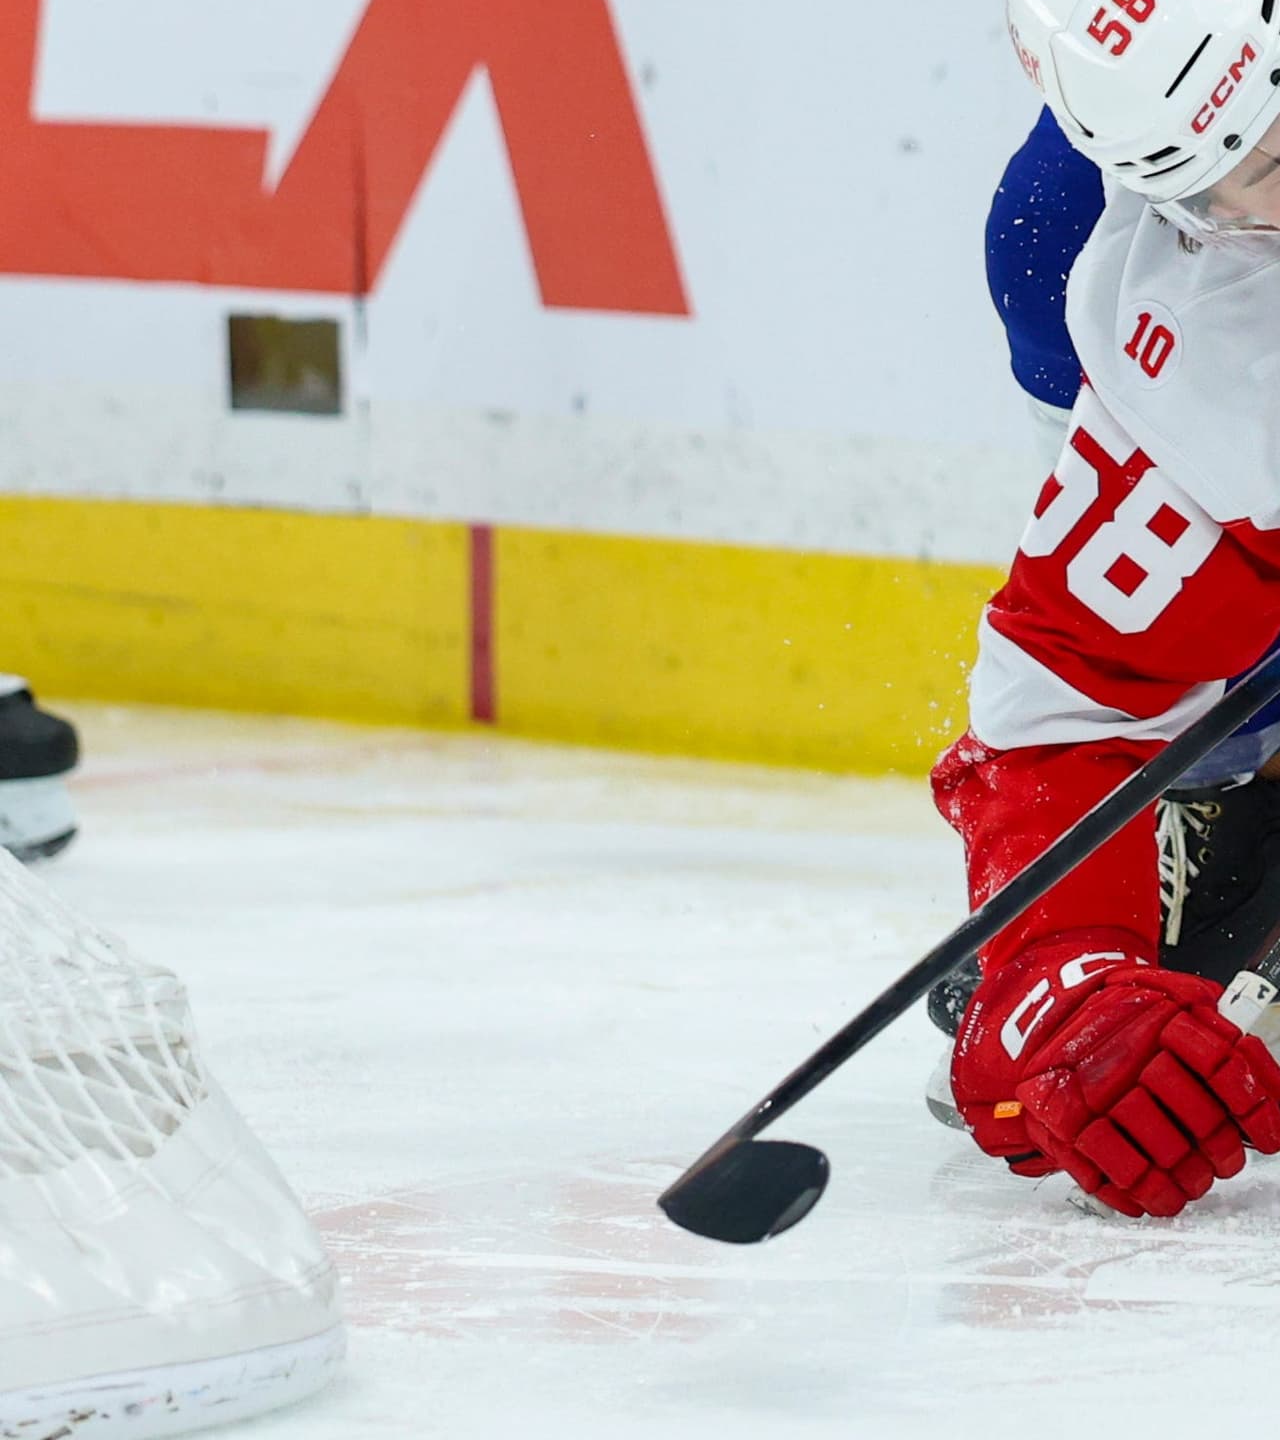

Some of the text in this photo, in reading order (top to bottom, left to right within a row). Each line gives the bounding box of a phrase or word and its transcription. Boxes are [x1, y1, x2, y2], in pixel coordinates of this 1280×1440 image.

[1190, 42, 1257, 135] CCM
[1123, 312, 1175, 379] 10
[1019, 384, 1225, 635] 58
[1000, 951, 1150, 1061] CC
